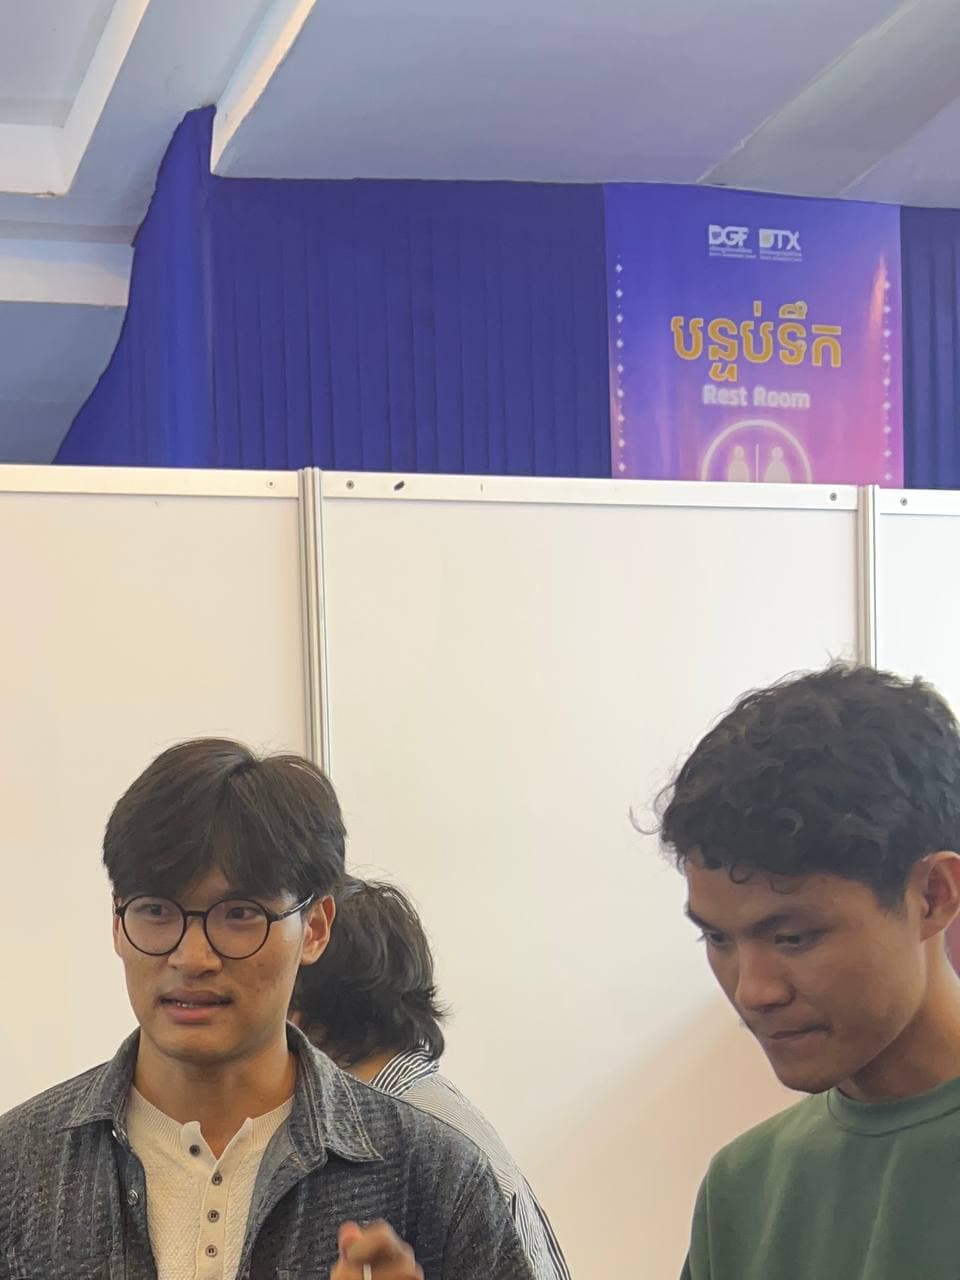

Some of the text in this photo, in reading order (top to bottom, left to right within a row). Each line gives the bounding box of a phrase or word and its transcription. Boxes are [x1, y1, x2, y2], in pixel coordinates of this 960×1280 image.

[708, 224, 802, 251] DGF DTX
[703, 383, 811, 409] Rest Room
